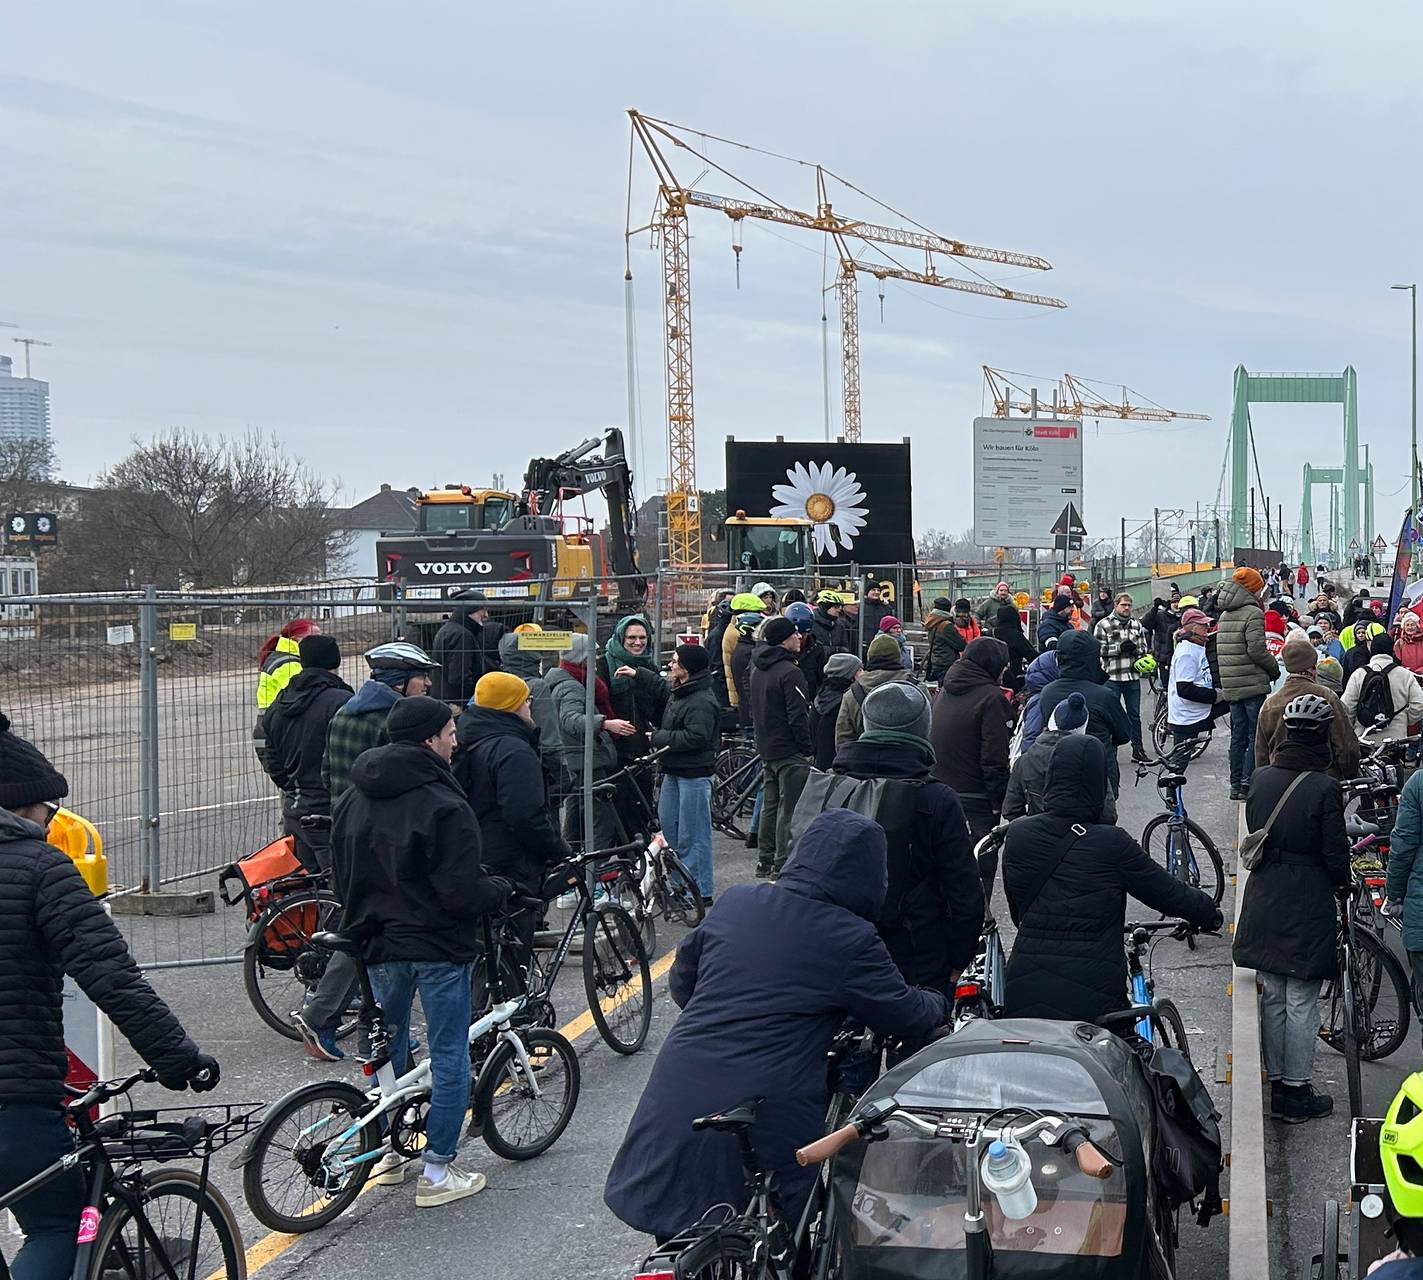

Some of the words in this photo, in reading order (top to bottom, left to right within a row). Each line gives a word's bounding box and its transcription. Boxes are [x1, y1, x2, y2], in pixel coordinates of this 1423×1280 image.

[585, 470, 606, 484] VOLVO
[689, 499, 696, 509] 4
[415, 561, 493, 575] VOLVO
